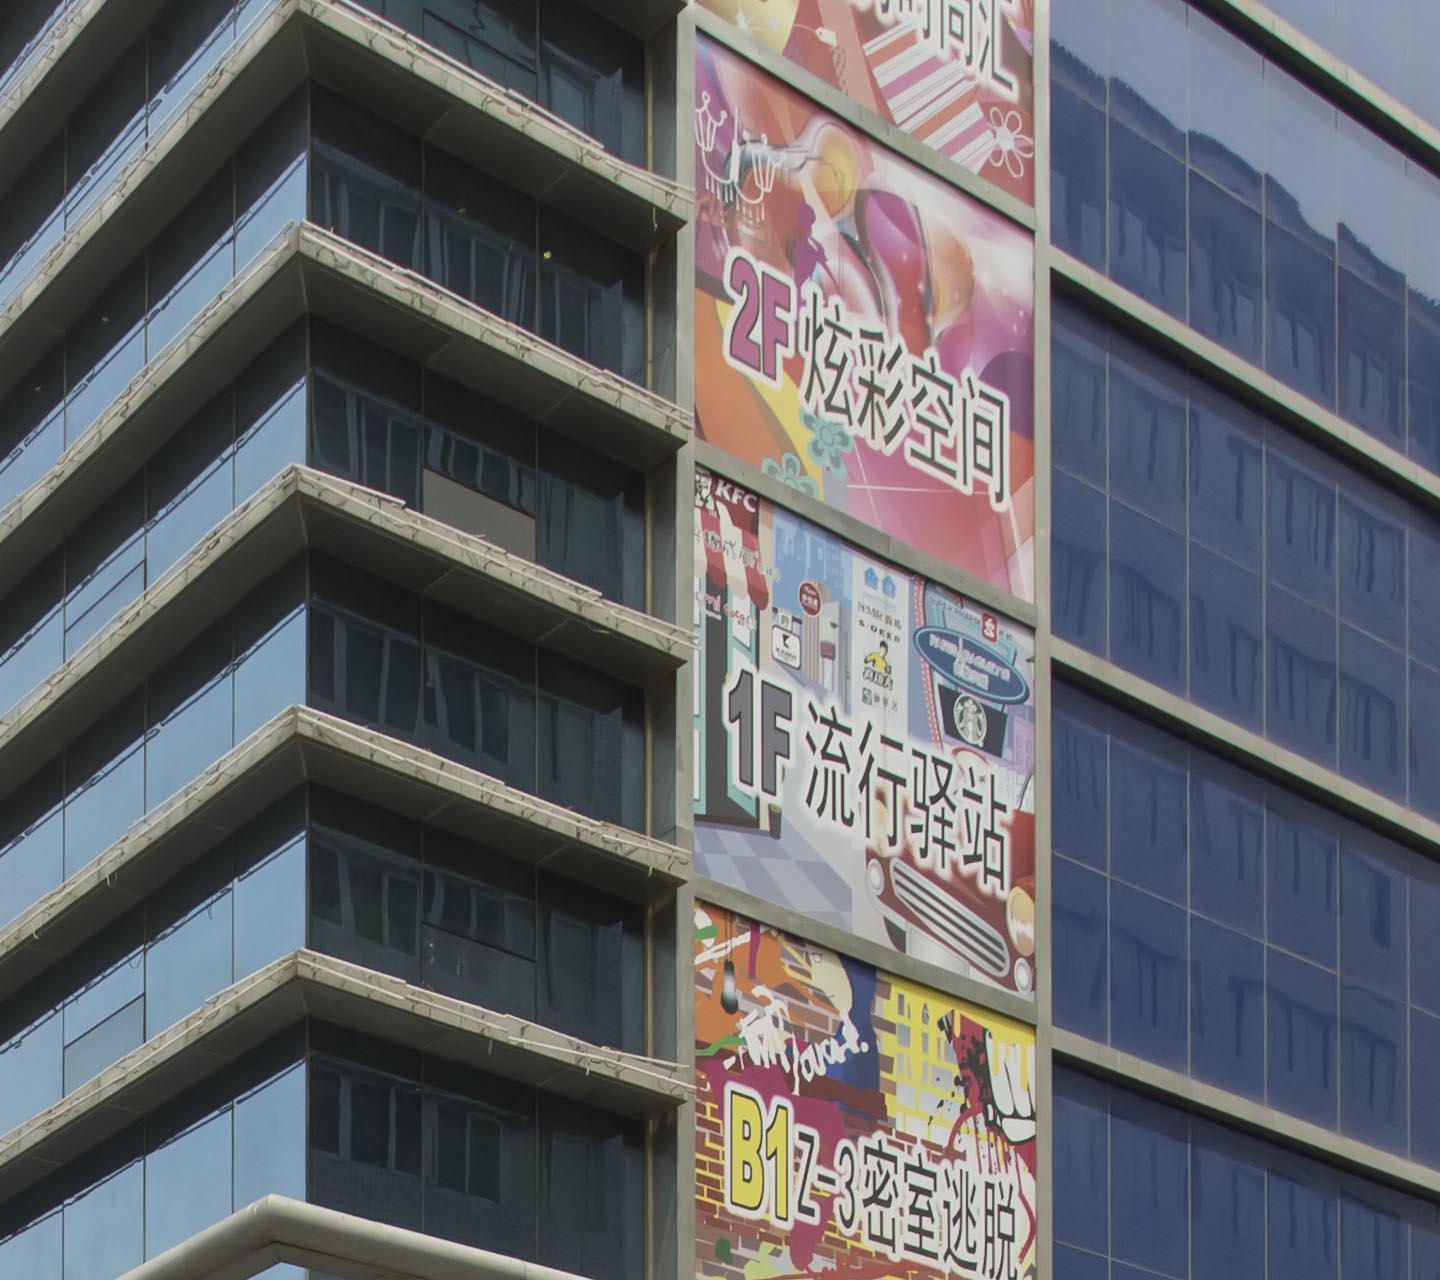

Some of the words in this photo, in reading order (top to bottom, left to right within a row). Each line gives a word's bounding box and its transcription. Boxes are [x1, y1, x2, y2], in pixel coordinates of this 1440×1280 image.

[728, 256, 793, 380] 2F
[804, 290, 1010, 505] 炫彩空间
[713, 477, 758, 514] KFC
[728, 669, 792, 797] 1F
[805, 700, 1010, 890] 流行驿站
[727, 1090, 791, 1223] B1
